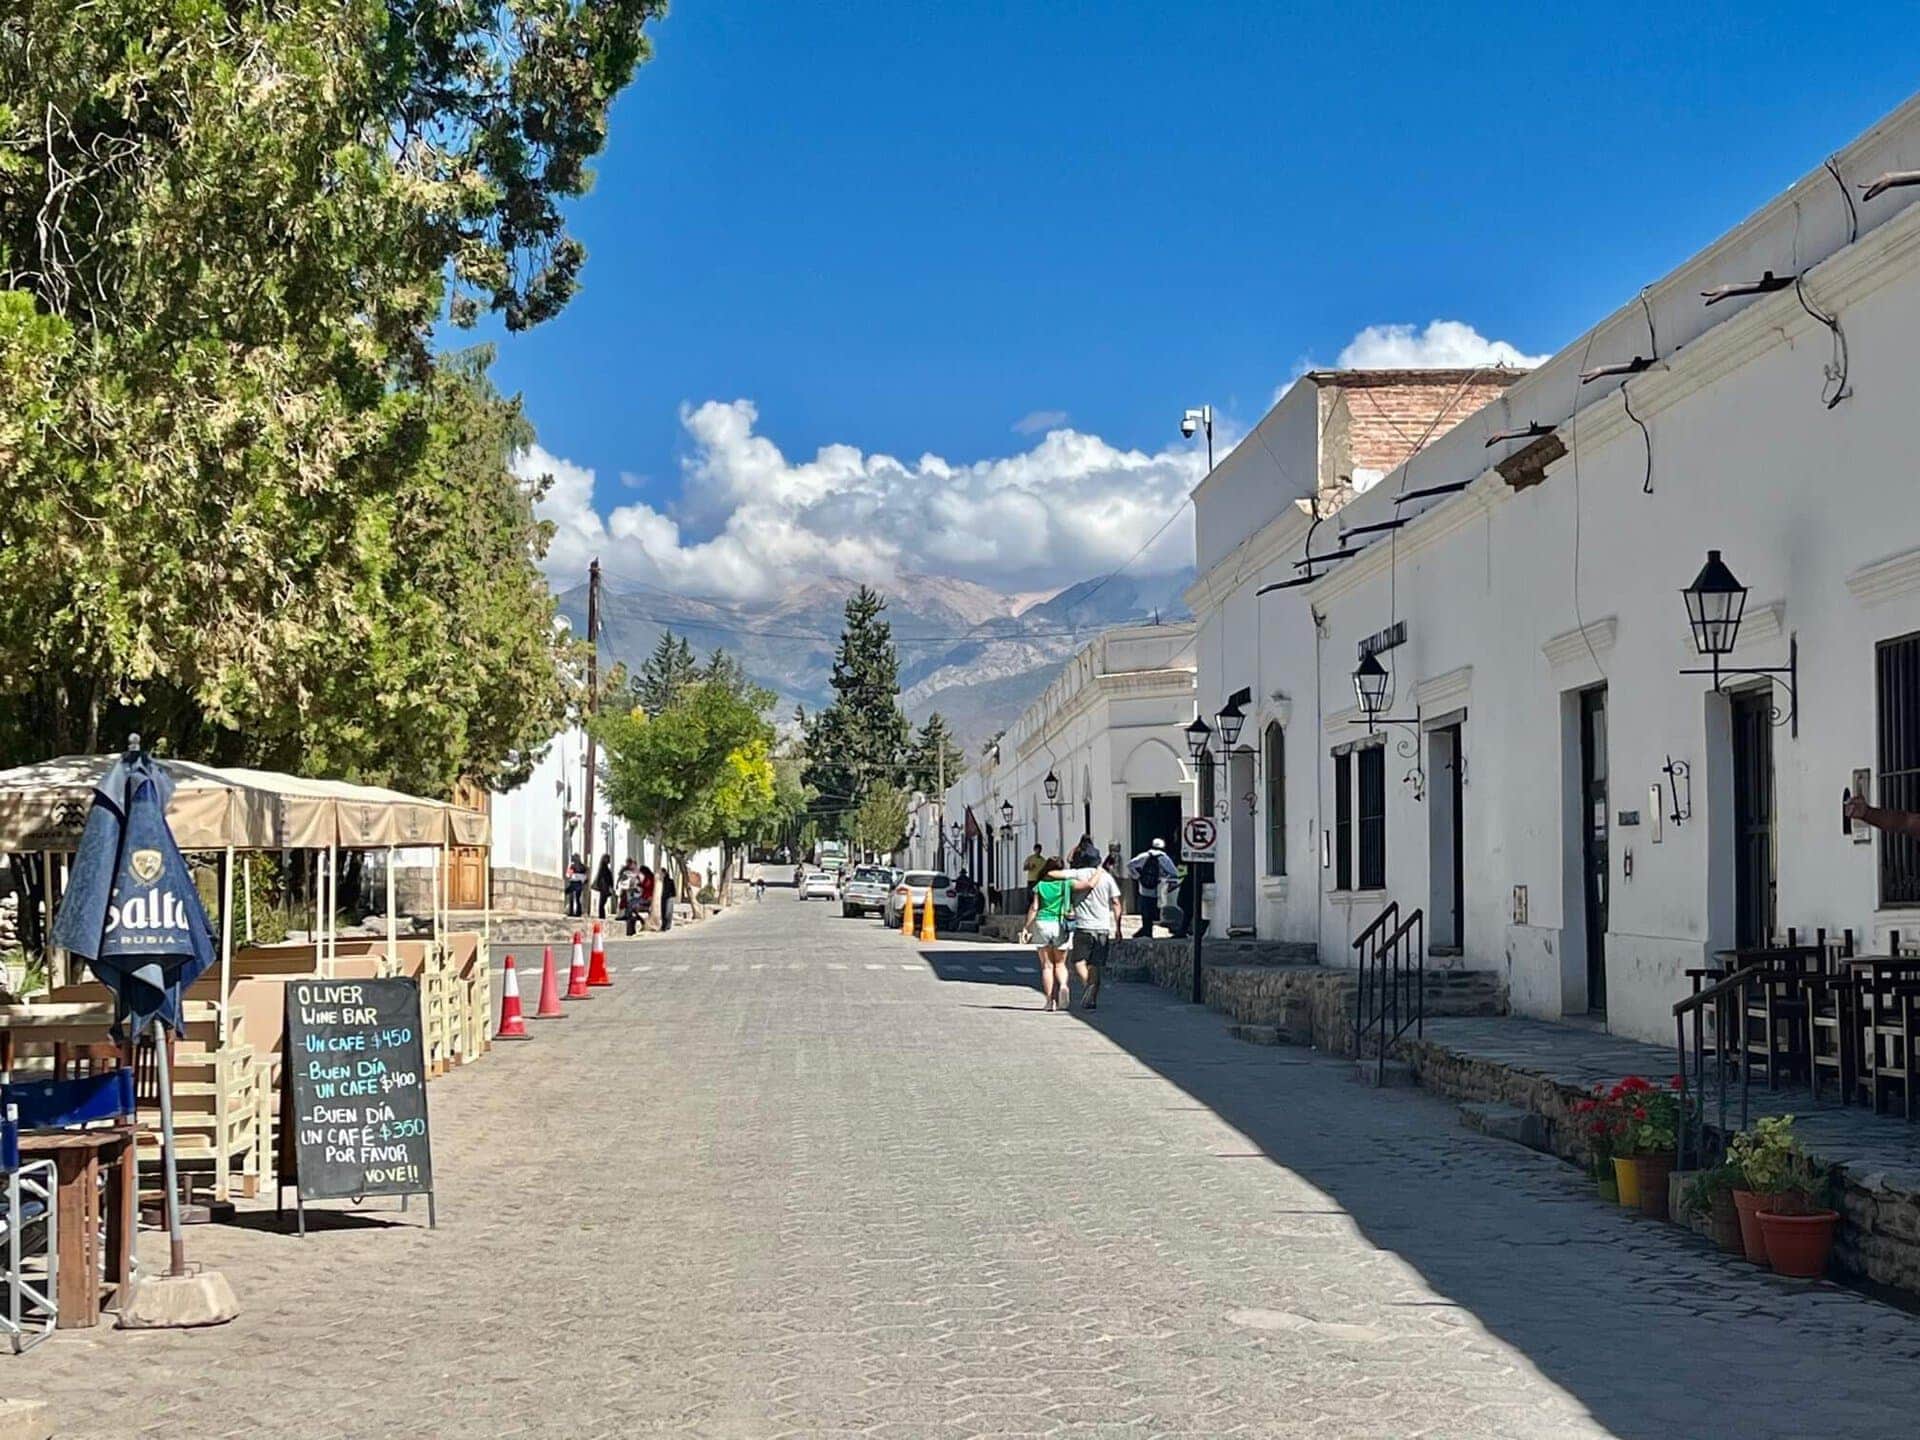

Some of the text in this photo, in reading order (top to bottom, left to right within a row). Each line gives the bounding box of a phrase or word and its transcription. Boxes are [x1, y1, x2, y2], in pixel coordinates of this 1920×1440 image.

[121, 935, 175, 945] RUBIA
[342, 1007, 377, 1026] BAR
[328, 1031, 365, 1051] CAFÉ
[370, 1028, 411, 1049] $450
[357, 1057, 388, 1078] DÍA
[315, 1083, 335, 1099] UN
[380, 1071, 416, 1093] $400
[365, 1101, 395, 1124] DÍA
[301, 1118, 425, 1147] UN CAFÉ $350
[361, 1143, 408, 1163] FAVOR
